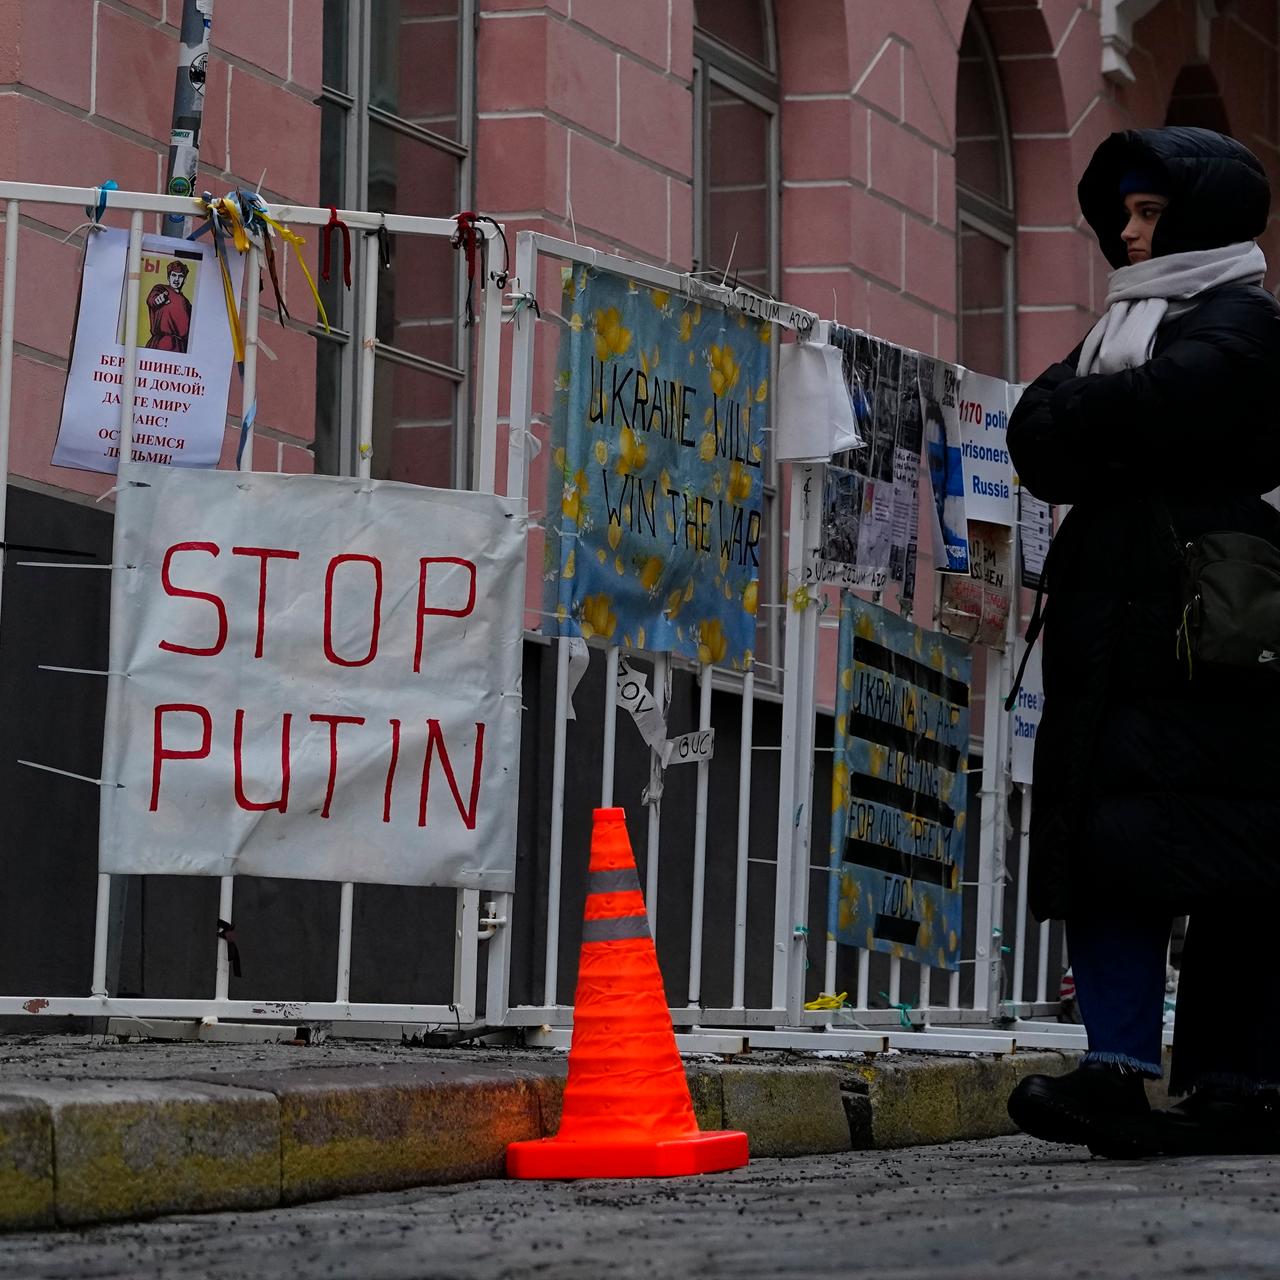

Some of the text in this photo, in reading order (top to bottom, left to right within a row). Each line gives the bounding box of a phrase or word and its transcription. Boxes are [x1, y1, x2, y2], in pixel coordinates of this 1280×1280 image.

[141, 258, 160, 274] Ы
[101, 354, 202, 380] БЕР ШИНЕЛЬ,
[150, 379, 205, 396] ДОМОЙ!
[102, 392, 192, 414] ДАТЕ МИРУ
[590, 356, 760, 468] UKRAINE WILL
[959, 400, 1008, 430] 1170 polit
[132, 413, 168, 428] АНС!
[972, 475, 1008, 498] Russia
[603, 469, 761, 567] WIN THE WAR
[158, 541, 476, 673] STOP
[149, 703, 485, 830] PUTIN
[850, 802, 874, 840] FOR
